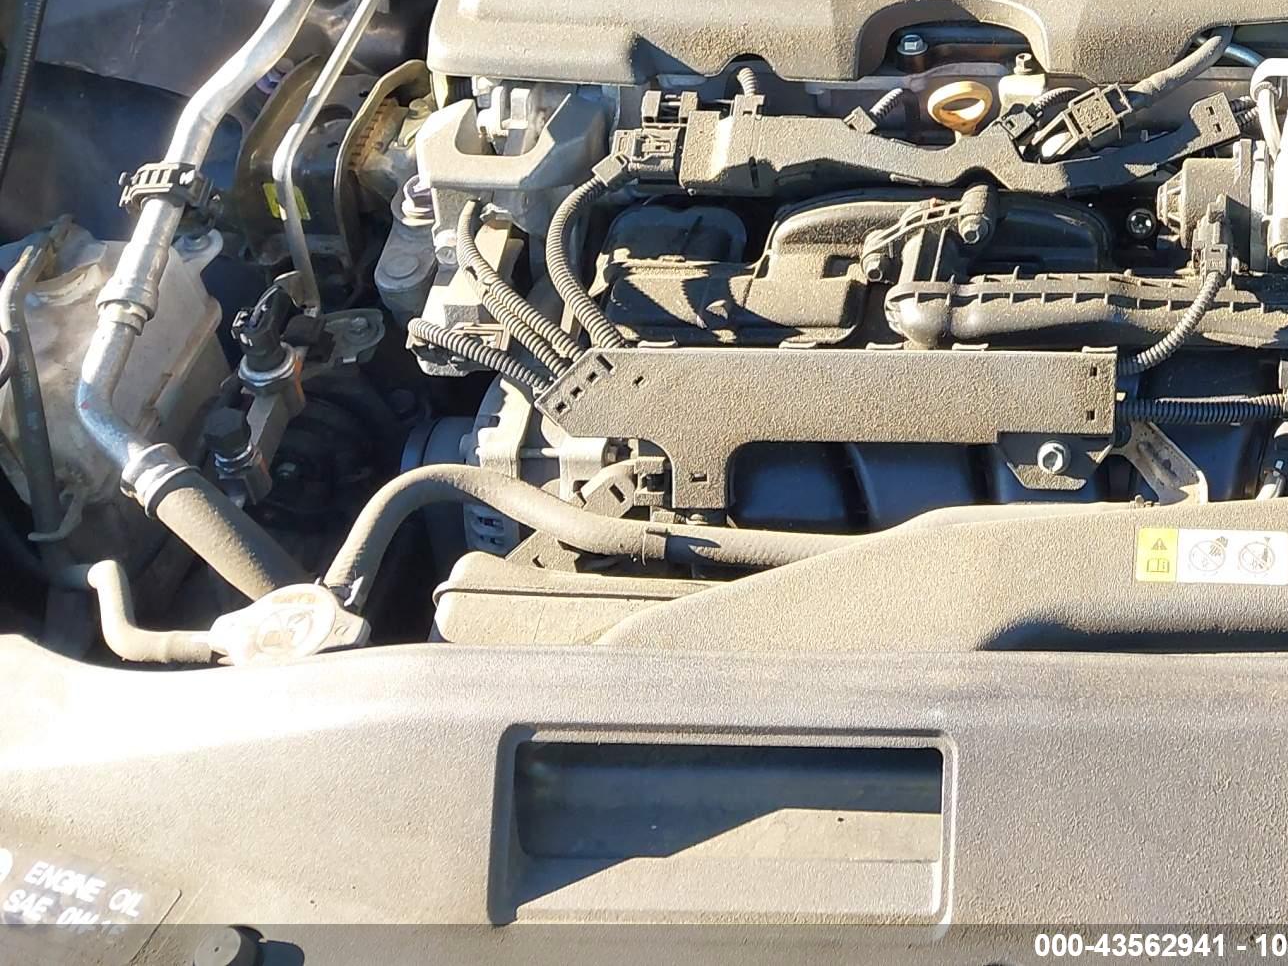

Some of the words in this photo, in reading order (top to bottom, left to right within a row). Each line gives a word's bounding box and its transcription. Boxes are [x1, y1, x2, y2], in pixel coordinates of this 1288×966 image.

[2, 889, 54, 921] SAE
[24, 861, 106, 902] ENGINE
[109, 888, 144, 917] OIL
